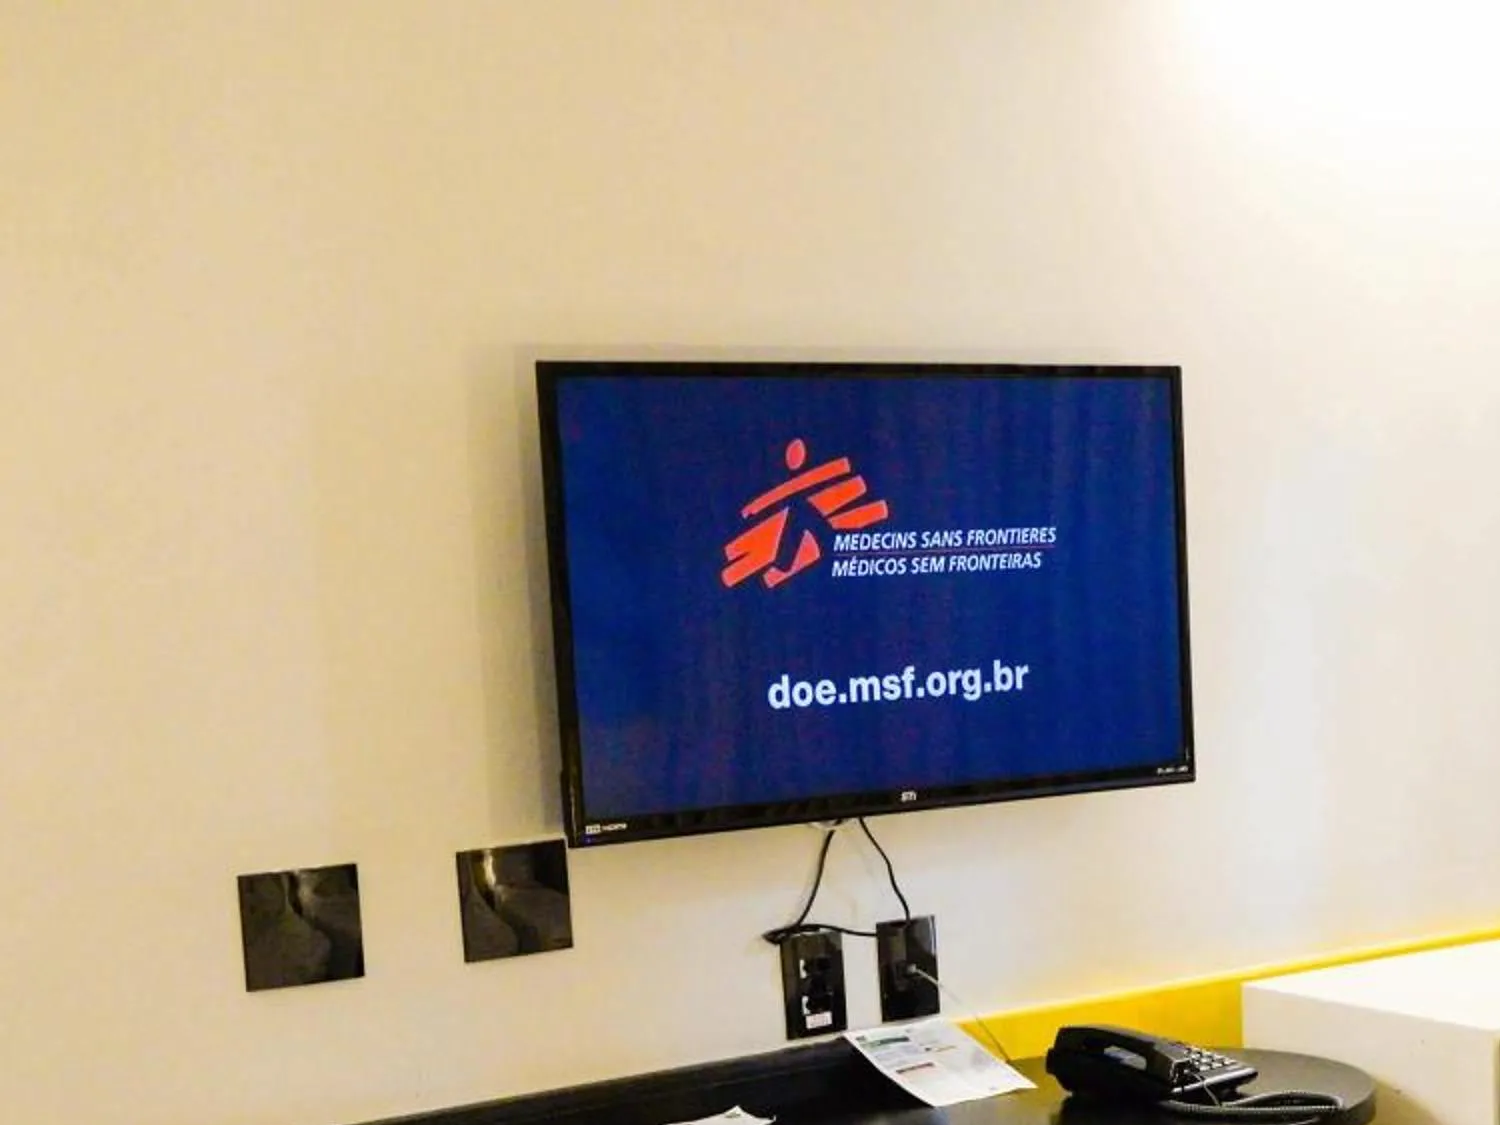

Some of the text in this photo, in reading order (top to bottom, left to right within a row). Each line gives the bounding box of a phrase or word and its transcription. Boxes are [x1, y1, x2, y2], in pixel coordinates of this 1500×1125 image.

[833, 526, 1057, 551] MEDECINS SANS FRONTIERES
[831, 551, 1042, 577] MÉDICOS SEM FRONTEIRAS
[767, 659, 1029, 710] doe.msf.org.br
